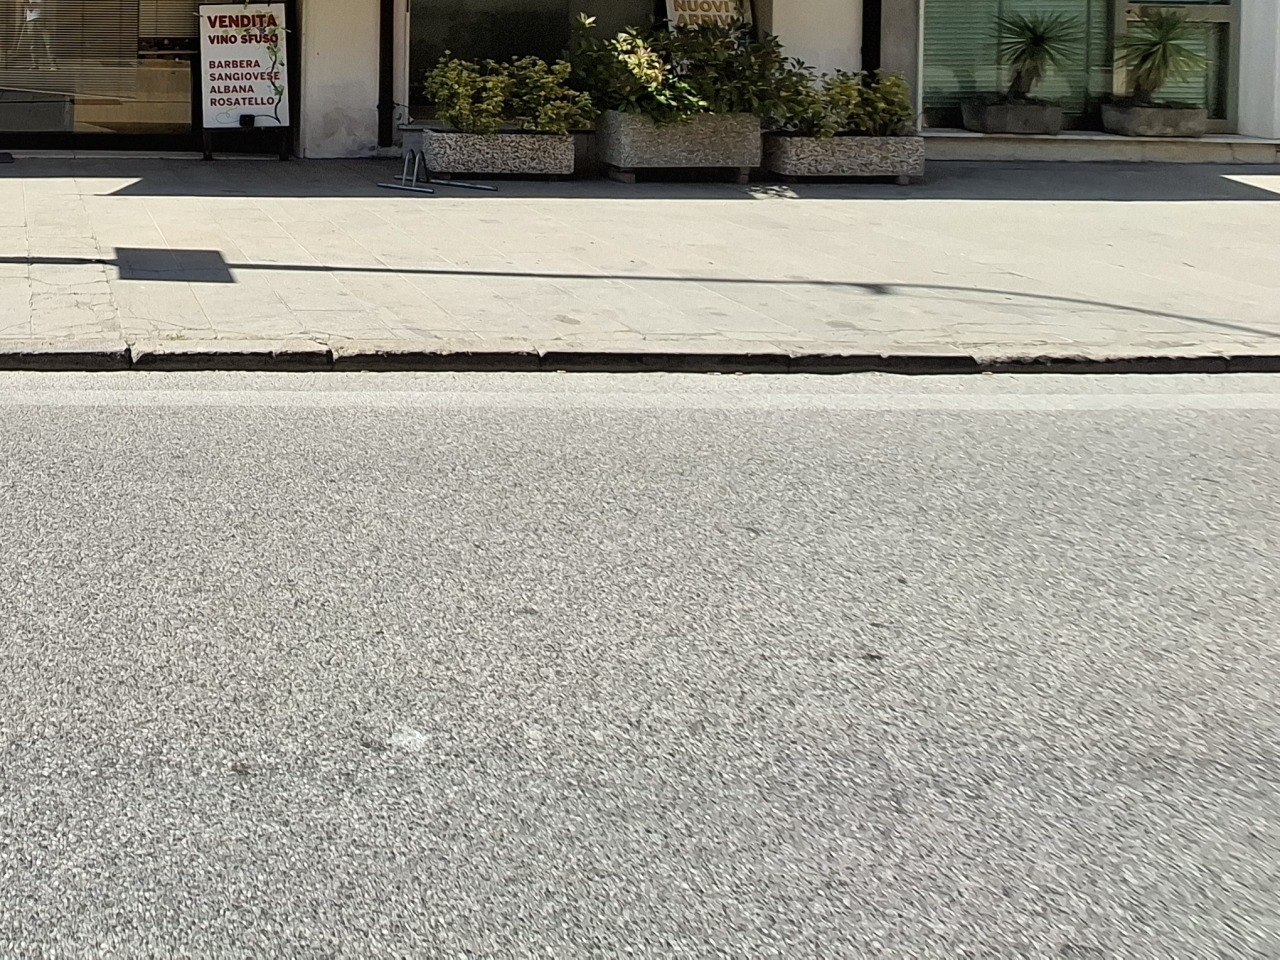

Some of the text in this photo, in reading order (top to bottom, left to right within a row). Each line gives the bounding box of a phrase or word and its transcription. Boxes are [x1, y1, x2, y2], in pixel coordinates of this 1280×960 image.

[674, 0, 730, 13] NUOVI
[207, 14, 278, 28] VENDITA
[208, 33, 279, 45] VINO SFUSO
[209, 60, 261, 69] BARBERA
[209, 72, 280, 82] SANGIOVESE
[210, 85, 255, 94] ALBANA
[210, 97, 275, 107] ROSATELLO
